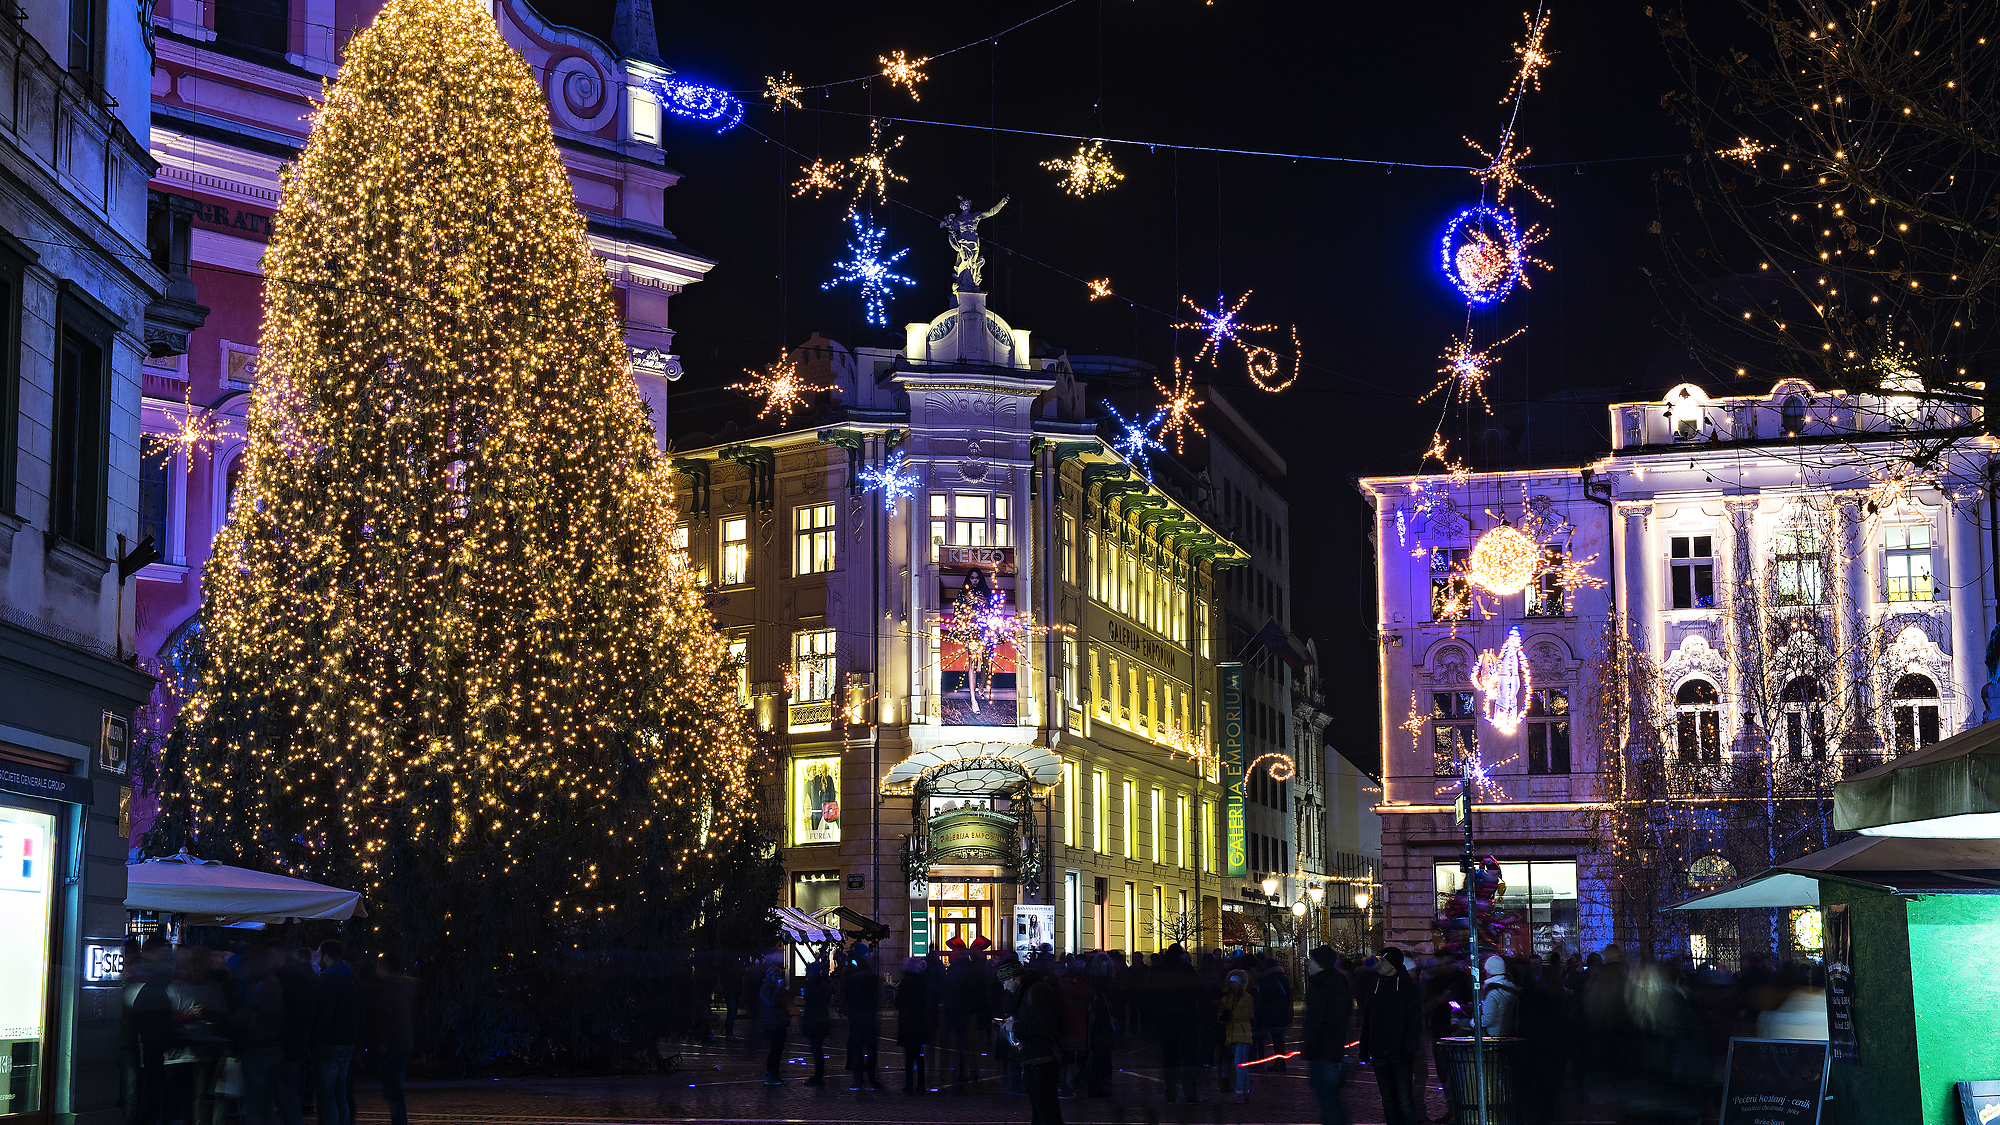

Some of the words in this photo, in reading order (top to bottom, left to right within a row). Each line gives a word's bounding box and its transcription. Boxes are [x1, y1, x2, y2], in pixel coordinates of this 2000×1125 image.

[197, 203, 274, 236] GRATI
[949, 549, 1005, 563] KENZO
[1109, 620, 1140, 653] GALERIJA
[1142, 638, 1175, 671] EMPORIUM
[1226, 674, 1241, 776] EMPORIUM
[21, 774, 47, 789] GENERALE
[47, 780, 66, 792] GROUP
[1228, 781, 1244, 867] GALERIJA
[810, 832, 832, 840] FURLA
[940, 832, 970, 844] GALERIJA
[971, 832, 1007, 844] EMPORIUM
[103, 953, 125, 974] SKB
[1732, 1094, 1758, 1105] Pečeni
[1758, 1094, 1787, 1106] kostanj
[1791, 1098, 1812, 1109] cenik
